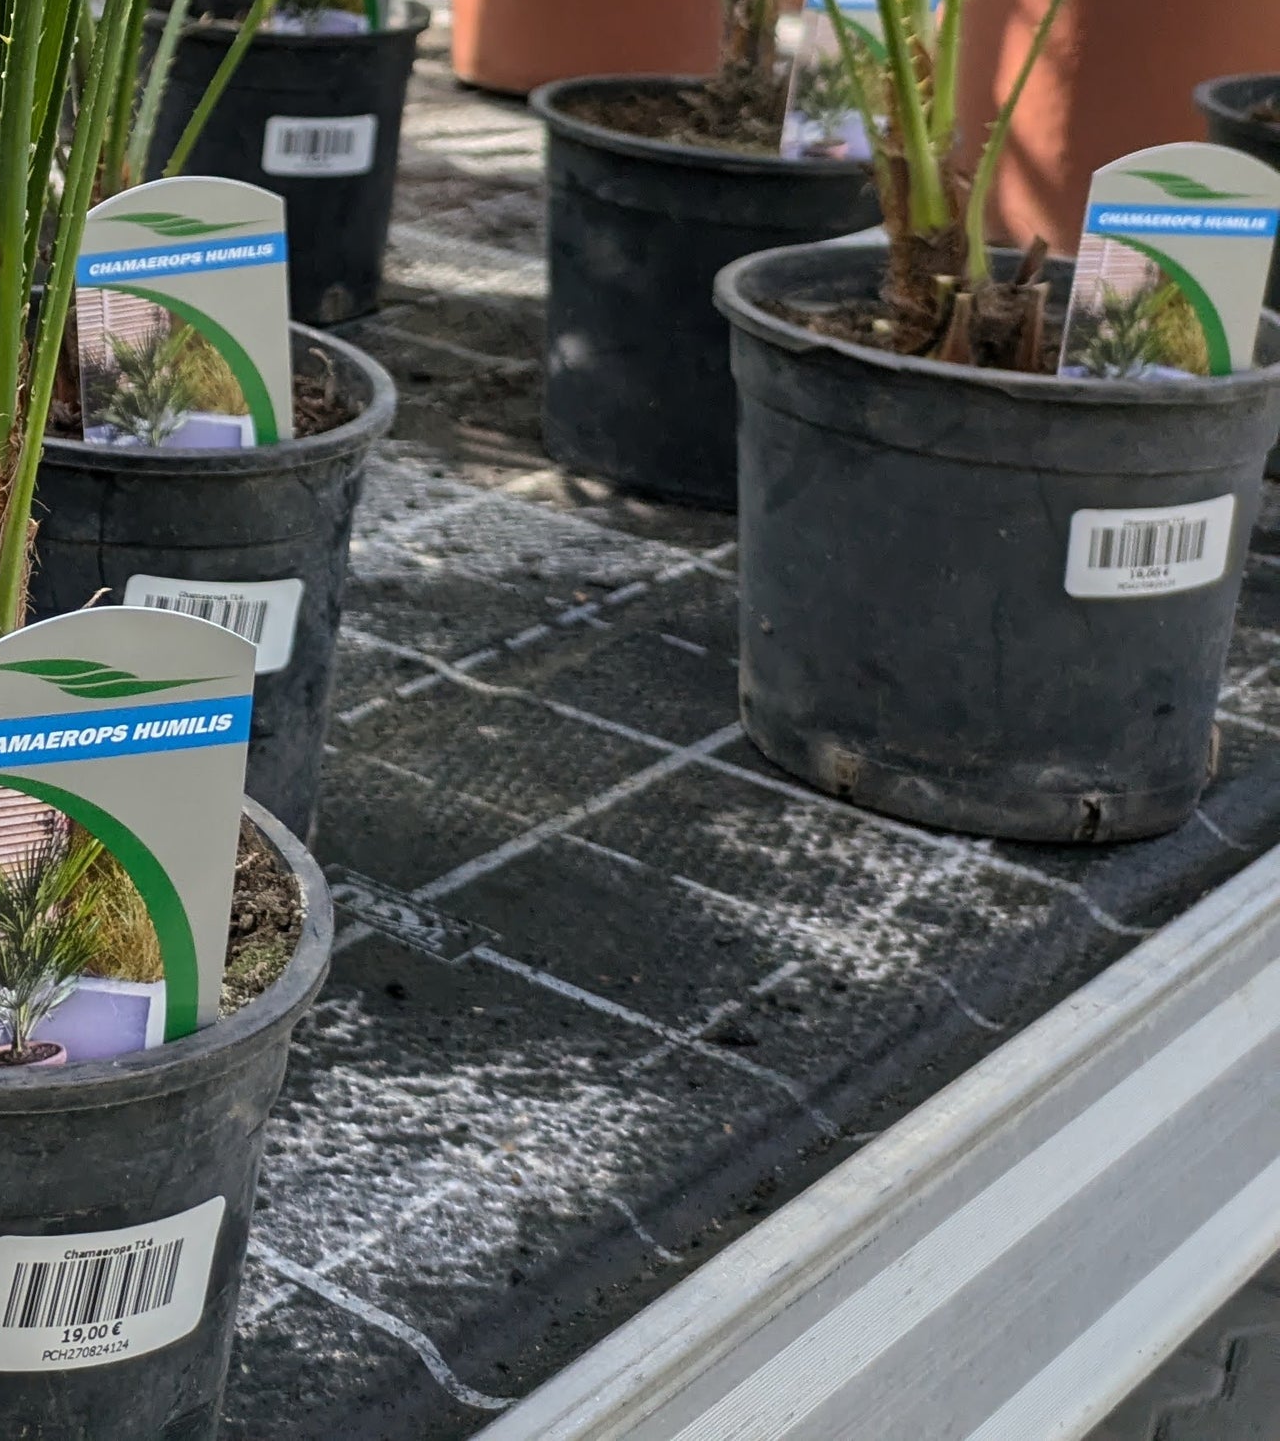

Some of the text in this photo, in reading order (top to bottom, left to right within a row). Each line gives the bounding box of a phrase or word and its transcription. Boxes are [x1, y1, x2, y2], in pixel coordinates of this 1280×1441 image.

[89, 242, 275, 276] CHAMAEROPS HUMILIS
[132, 713, 233, 741] HUMILIS
[64, 1238, 154, 1260] Chamaerops T14
[61, 1321, 123, 1344] 19,00 €
[41, 1339, 130, 1361] PCH270824124
